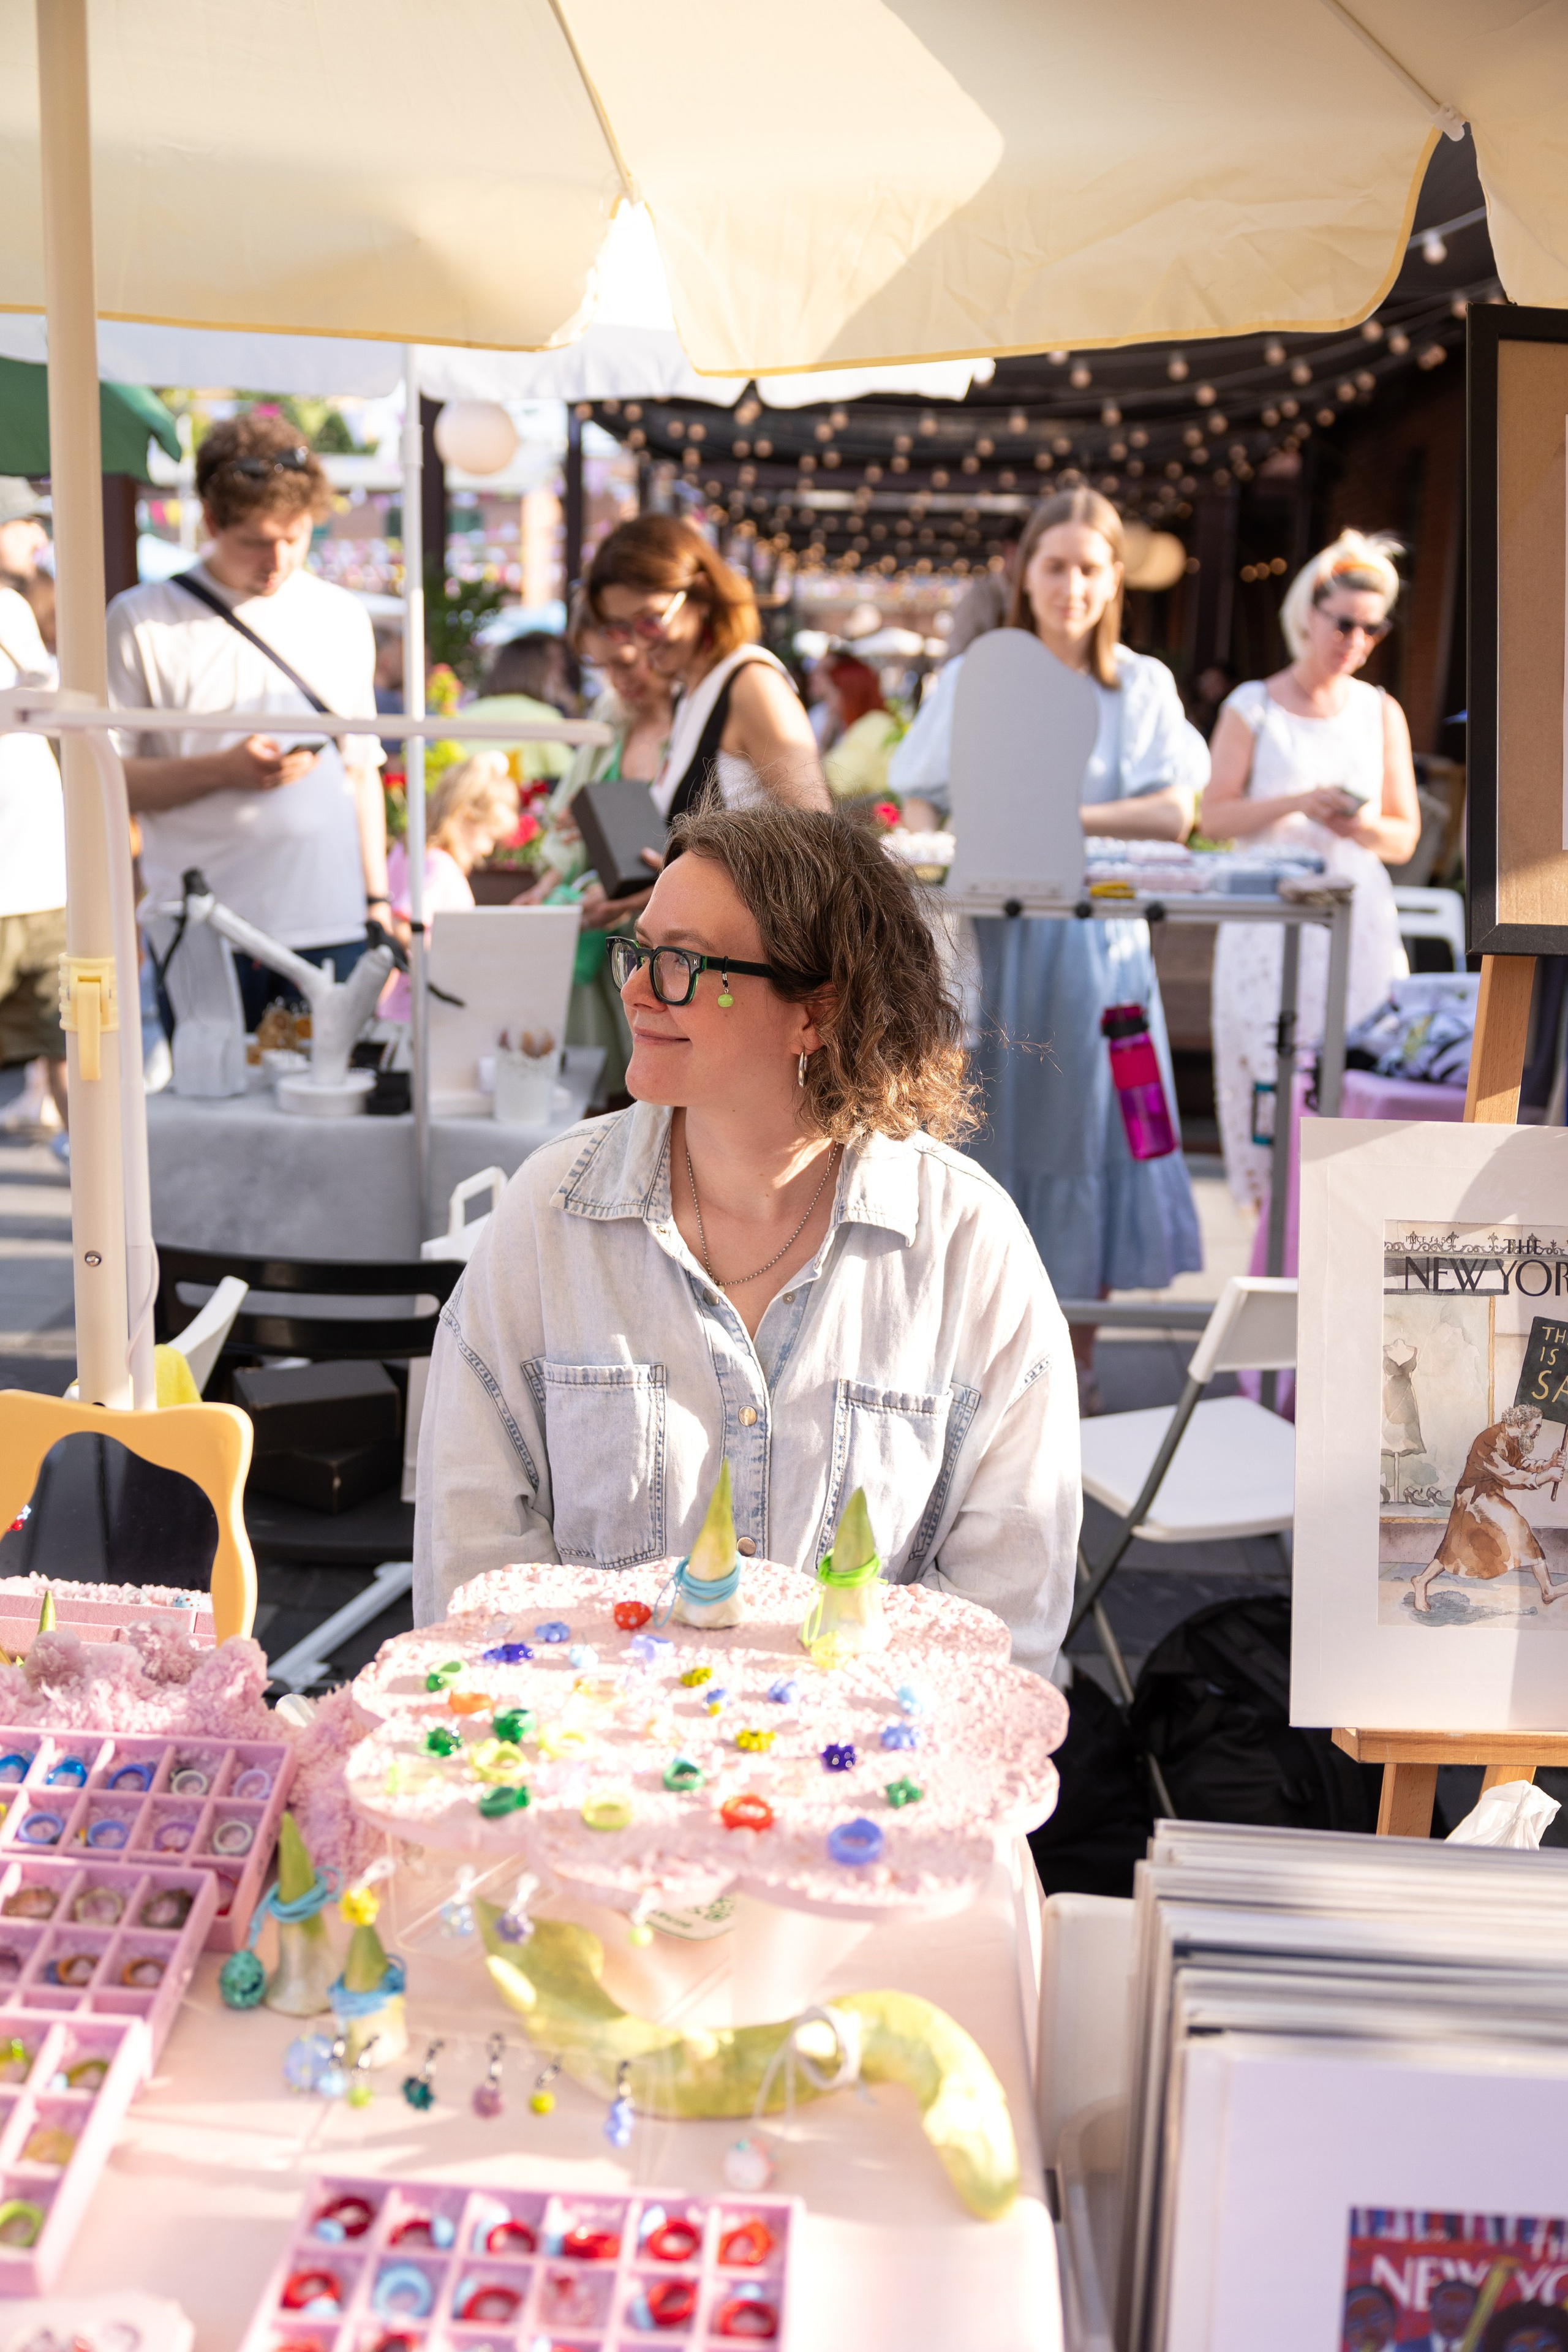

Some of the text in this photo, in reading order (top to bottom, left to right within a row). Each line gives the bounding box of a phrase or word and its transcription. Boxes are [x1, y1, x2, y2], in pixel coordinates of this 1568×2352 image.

[1406, 1235, 1427, 1244] PRICE
[1503, 1238, 1542, 1255] THE
[1405, 1256, 1489, 1292] NEW
[1542, 1326, 1568, 1344] TH
[1540, 1346, 1559, 1366] IS
